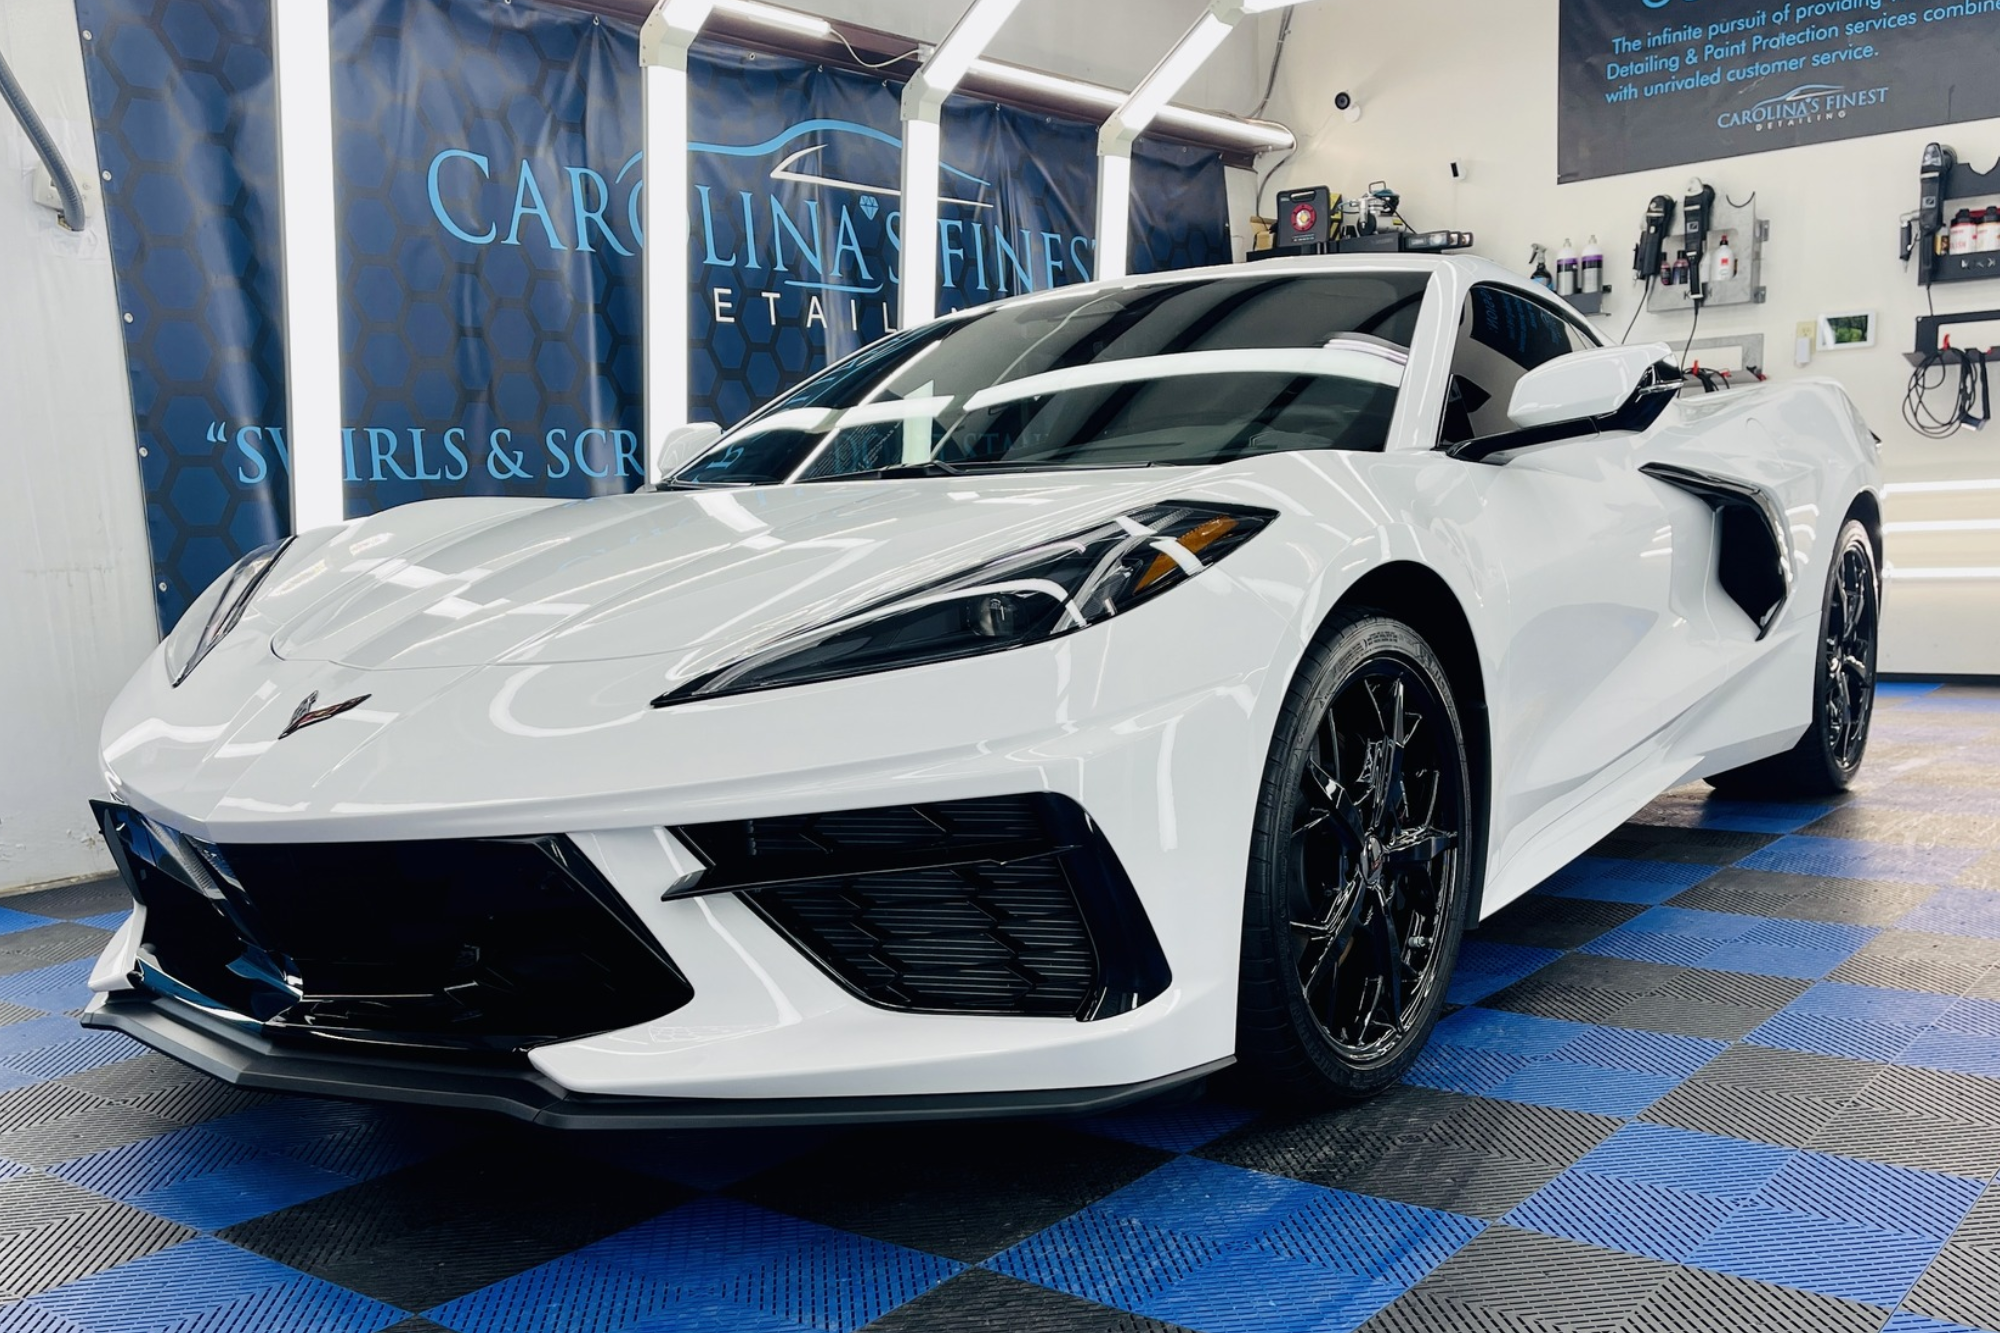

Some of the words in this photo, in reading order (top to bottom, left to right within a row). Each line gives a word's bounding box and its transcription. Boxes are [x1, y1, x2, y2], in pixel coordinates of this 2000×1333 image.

[1606, 55, 1680, 80] Detailing
[1684, 47, 1698, 65] &
[1704, 40, 1747, 62] Paint
[1752, 24, 1839, 52] Protection
[1845, 12, 1917, 36] services
[1611, 36, 1642, 55] The
[1647, 25, 1703, 48] infinite
[1708, 10, 1767, 41] pursuit
[1771, 3, 1791, 25] of
[1795, 0, 1882, 24] providing
[1605, 82, 1638, 103] with
[1643, 67, 1722, 97] unrivaled
[1726, 56, 1806, 82] customer
[1811, 44, 1879, 67] service.
[1826, 87, 1889, 111] FINEST
[1755, 110, 1847, 131] DETAILING
[937, 218, 1097, 293] FINES
[487, 428, 534, 480] &
[545, 428, 645, 478] SCR
